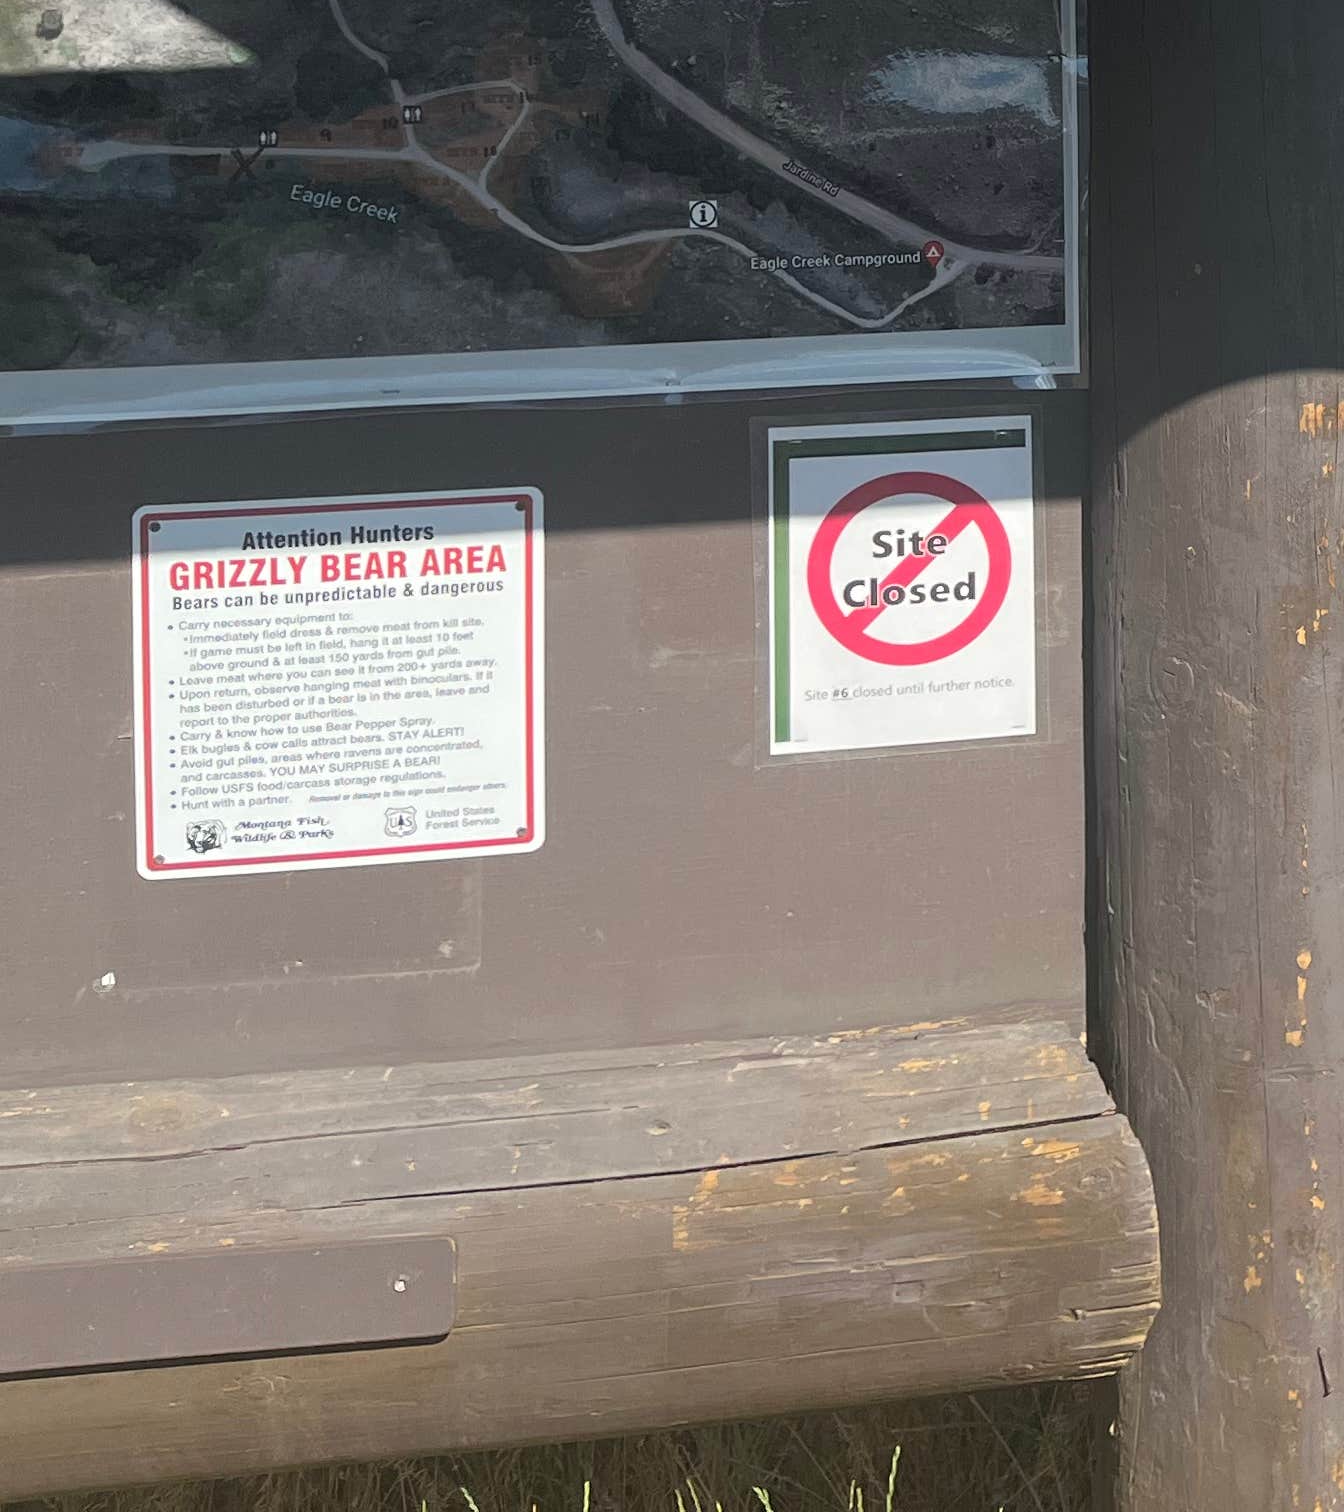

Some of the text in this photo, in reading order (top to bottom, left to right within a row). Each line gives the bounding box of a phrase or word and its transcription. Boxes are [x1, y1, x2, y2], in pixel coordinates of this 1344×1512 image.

[782, 160, 839, 197] Jardine Rd
[290, 184, 400, 224] Eagle Creek
[751, 250, 920, 271] Eagle Creek Campground
[242, 523, 434, 550] Attention Hunters
[872, 529, 947, 558] Site
[170, 544, 507, 590] GRIZZLY BEAR AREA
[172, 578, 504, 610] Bears can be unpredictable & dangerous
[844, 572, 976, 606] Closed
[804, 675, 1015, 702] Site #6 closed until further notice.
[181, 793, 291, 810] Hunt with a partner.
